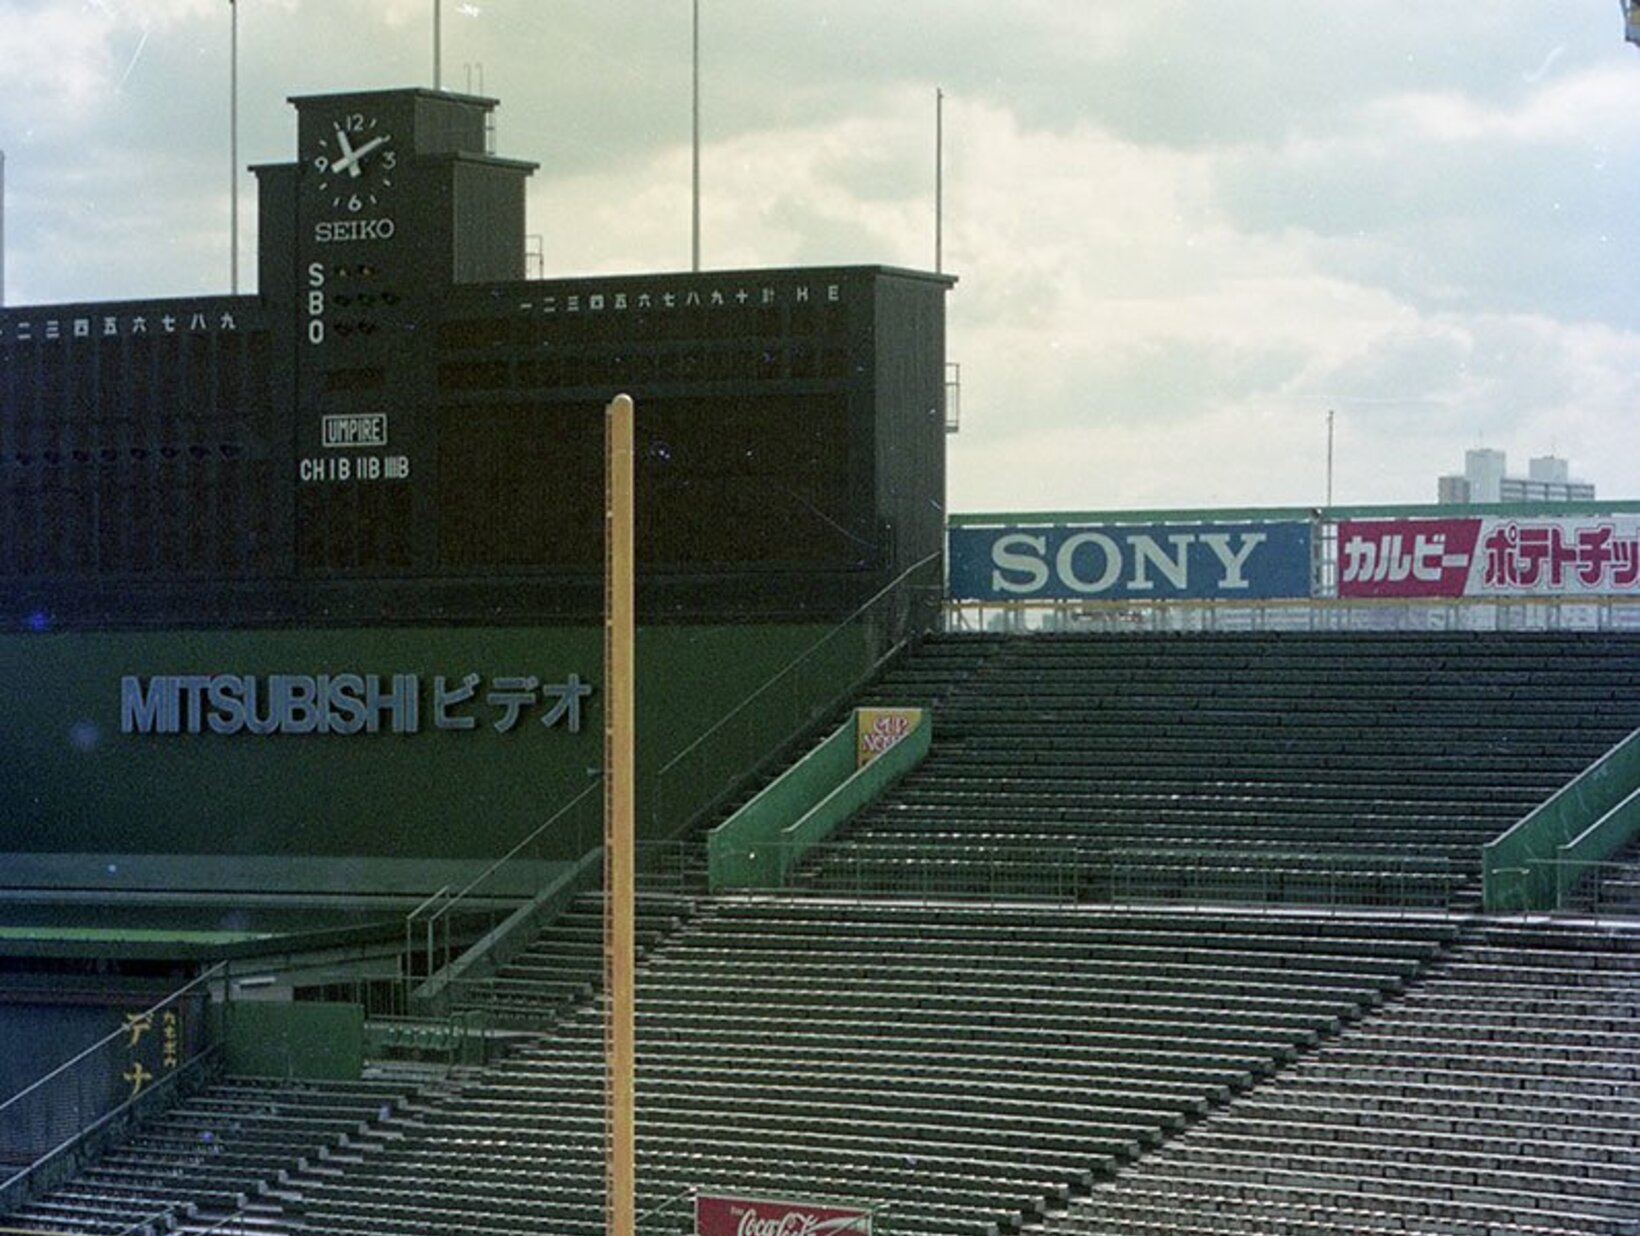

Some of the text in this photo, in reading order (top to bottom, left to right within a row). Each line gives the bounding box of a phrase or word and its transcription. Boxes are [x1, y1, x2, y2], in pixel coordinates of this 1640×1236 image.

[346, 112, 364, 132] 12
[314, 151, 397, 174] 9 3
[347, 193, 363, 212] 6
[314, 218, 395, 241] SEIKO
[308, 262, 325, 287] S
[308, 290, 325, 316] B
[308, 319, 325, 344] O
[327, 417, 381, 443] UMPIRE
[990, 532, 1267, 593] SONY
[1342, 533, 1469, 582] カルビー
[119, 672, 593, 735] MITSUBISHI ビデオ
